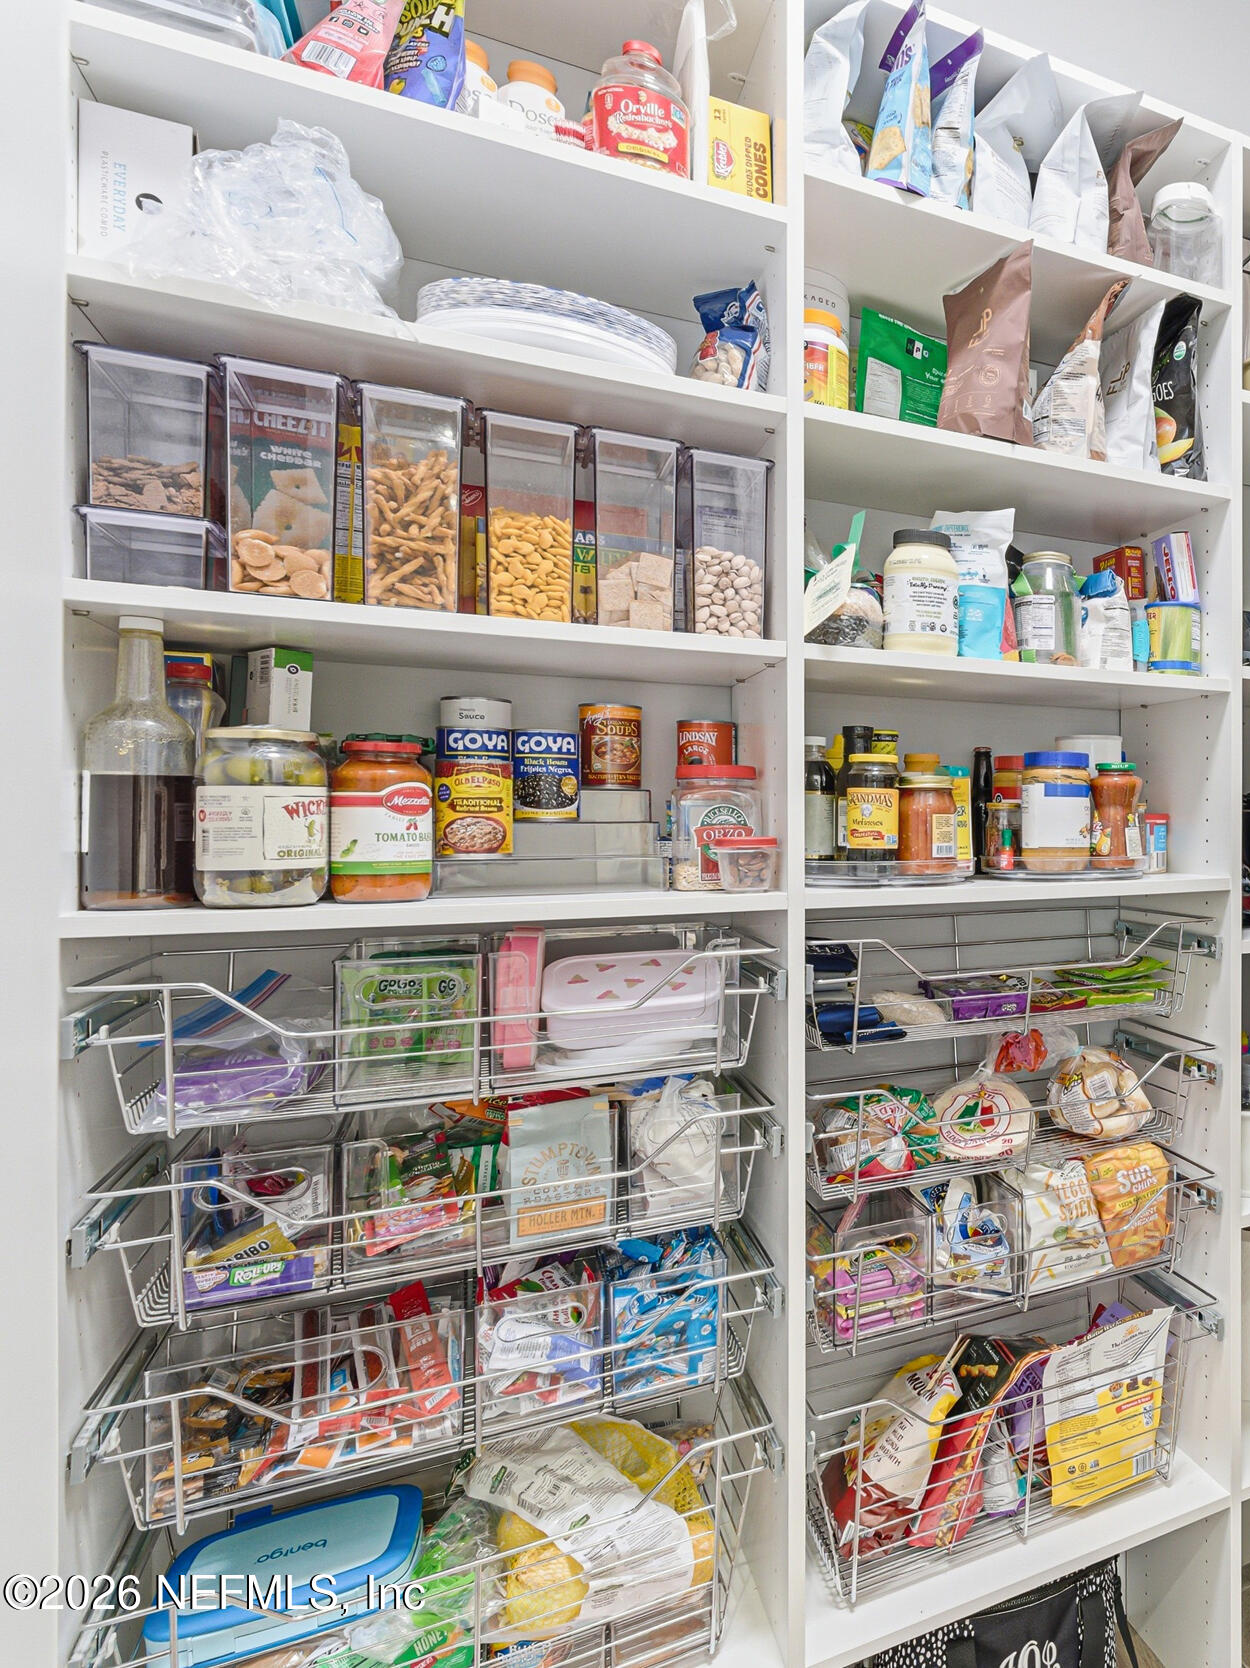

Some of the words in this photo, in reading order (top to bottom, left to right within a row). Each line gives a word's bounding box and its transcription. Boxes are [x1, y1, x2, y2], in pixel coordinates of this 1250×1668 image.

[620, 98, 665, 117] Orville
[754, 141, 769, 199] CONES
[113, 162, 127, 232] EVERYDAY
[458, 712, 486, 721] Sauce
[596, 721, 638, 736] SOUPS
[449, 732, 508, 750] GOYA
[517, 735, 575, 753] GOYA
[679, 731, 718, 746] LINDSAY
[375, 832, 416, 842] TOMATO
[521, 1142, 602, 1187] STUMPTOWN
[256, 1539, 328, 1564] bentgo
[413, 1630, 448, 1657] HONE
